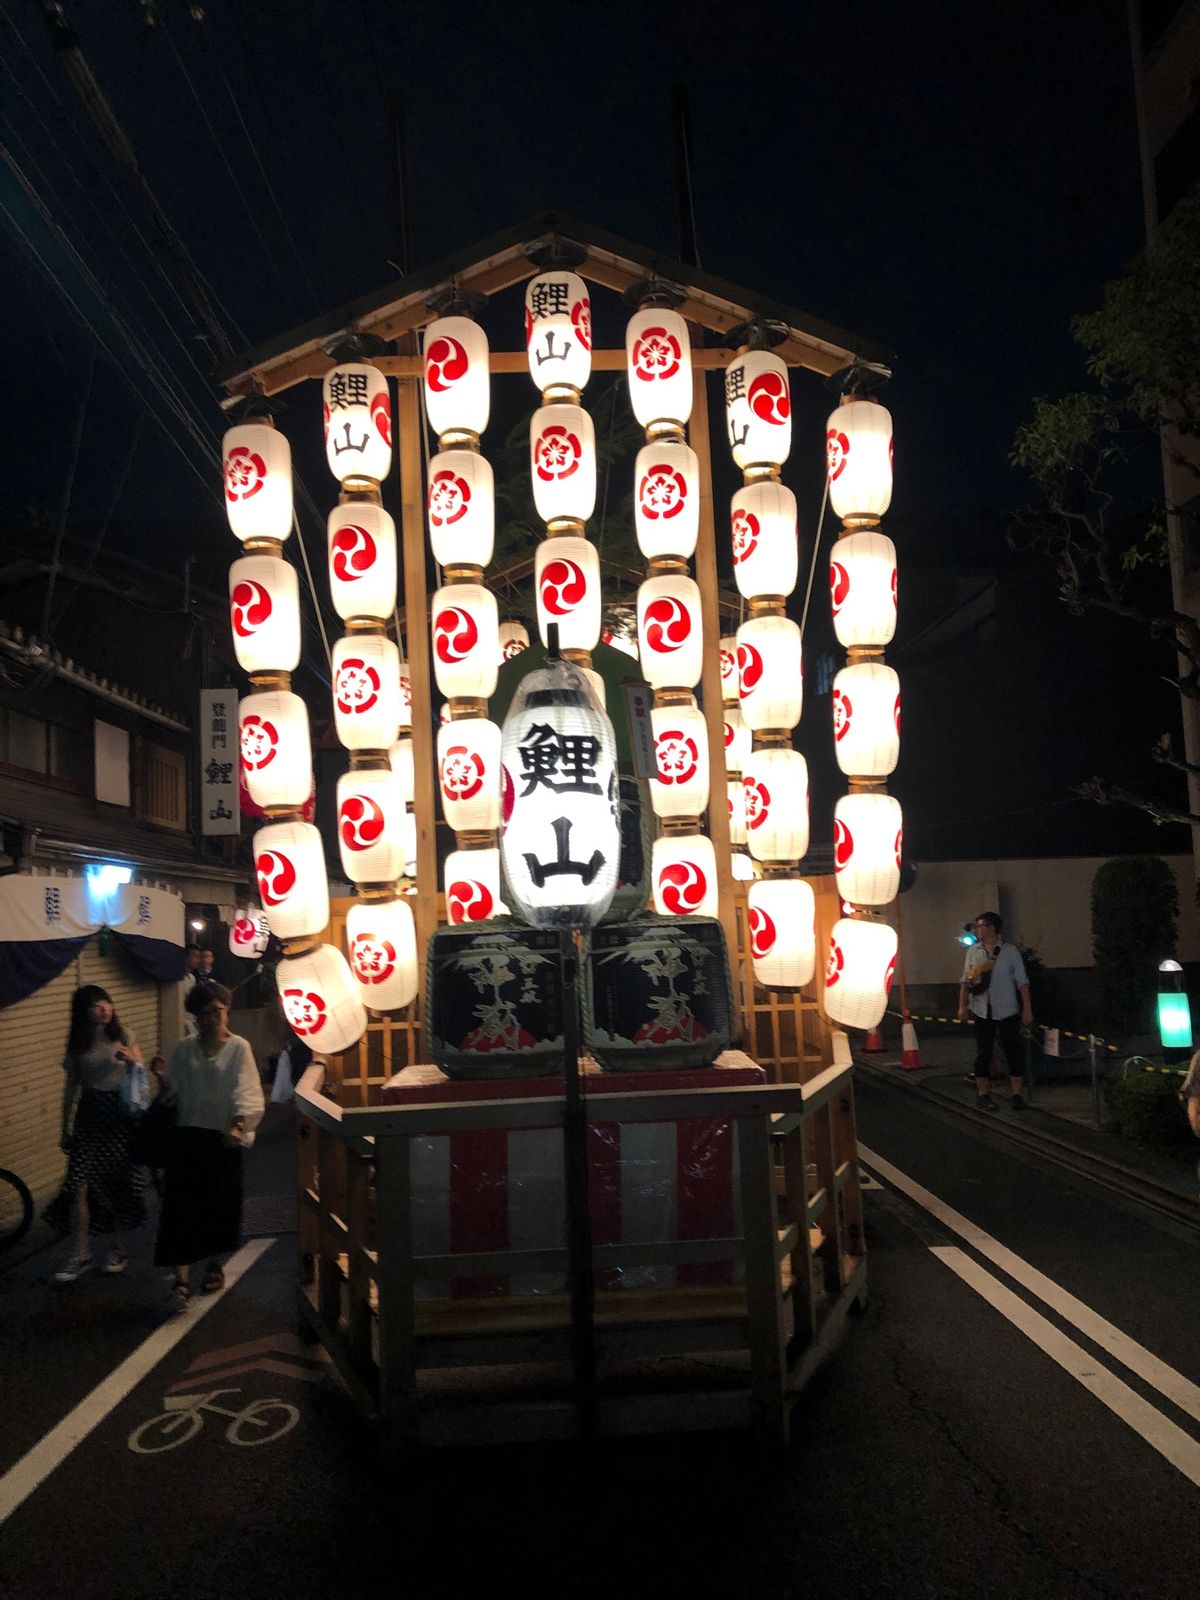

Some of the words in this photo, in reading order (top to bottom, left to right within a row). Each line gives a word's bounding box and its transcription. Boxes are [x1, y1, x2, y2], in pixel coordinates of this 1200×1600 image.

[531, 281, 572, 367] 鯉山
[329, 371, 371, 457] 鯉山
[205, 758, 233, 820] 鯉山
[517, 722, 607, 888] 鯉山
